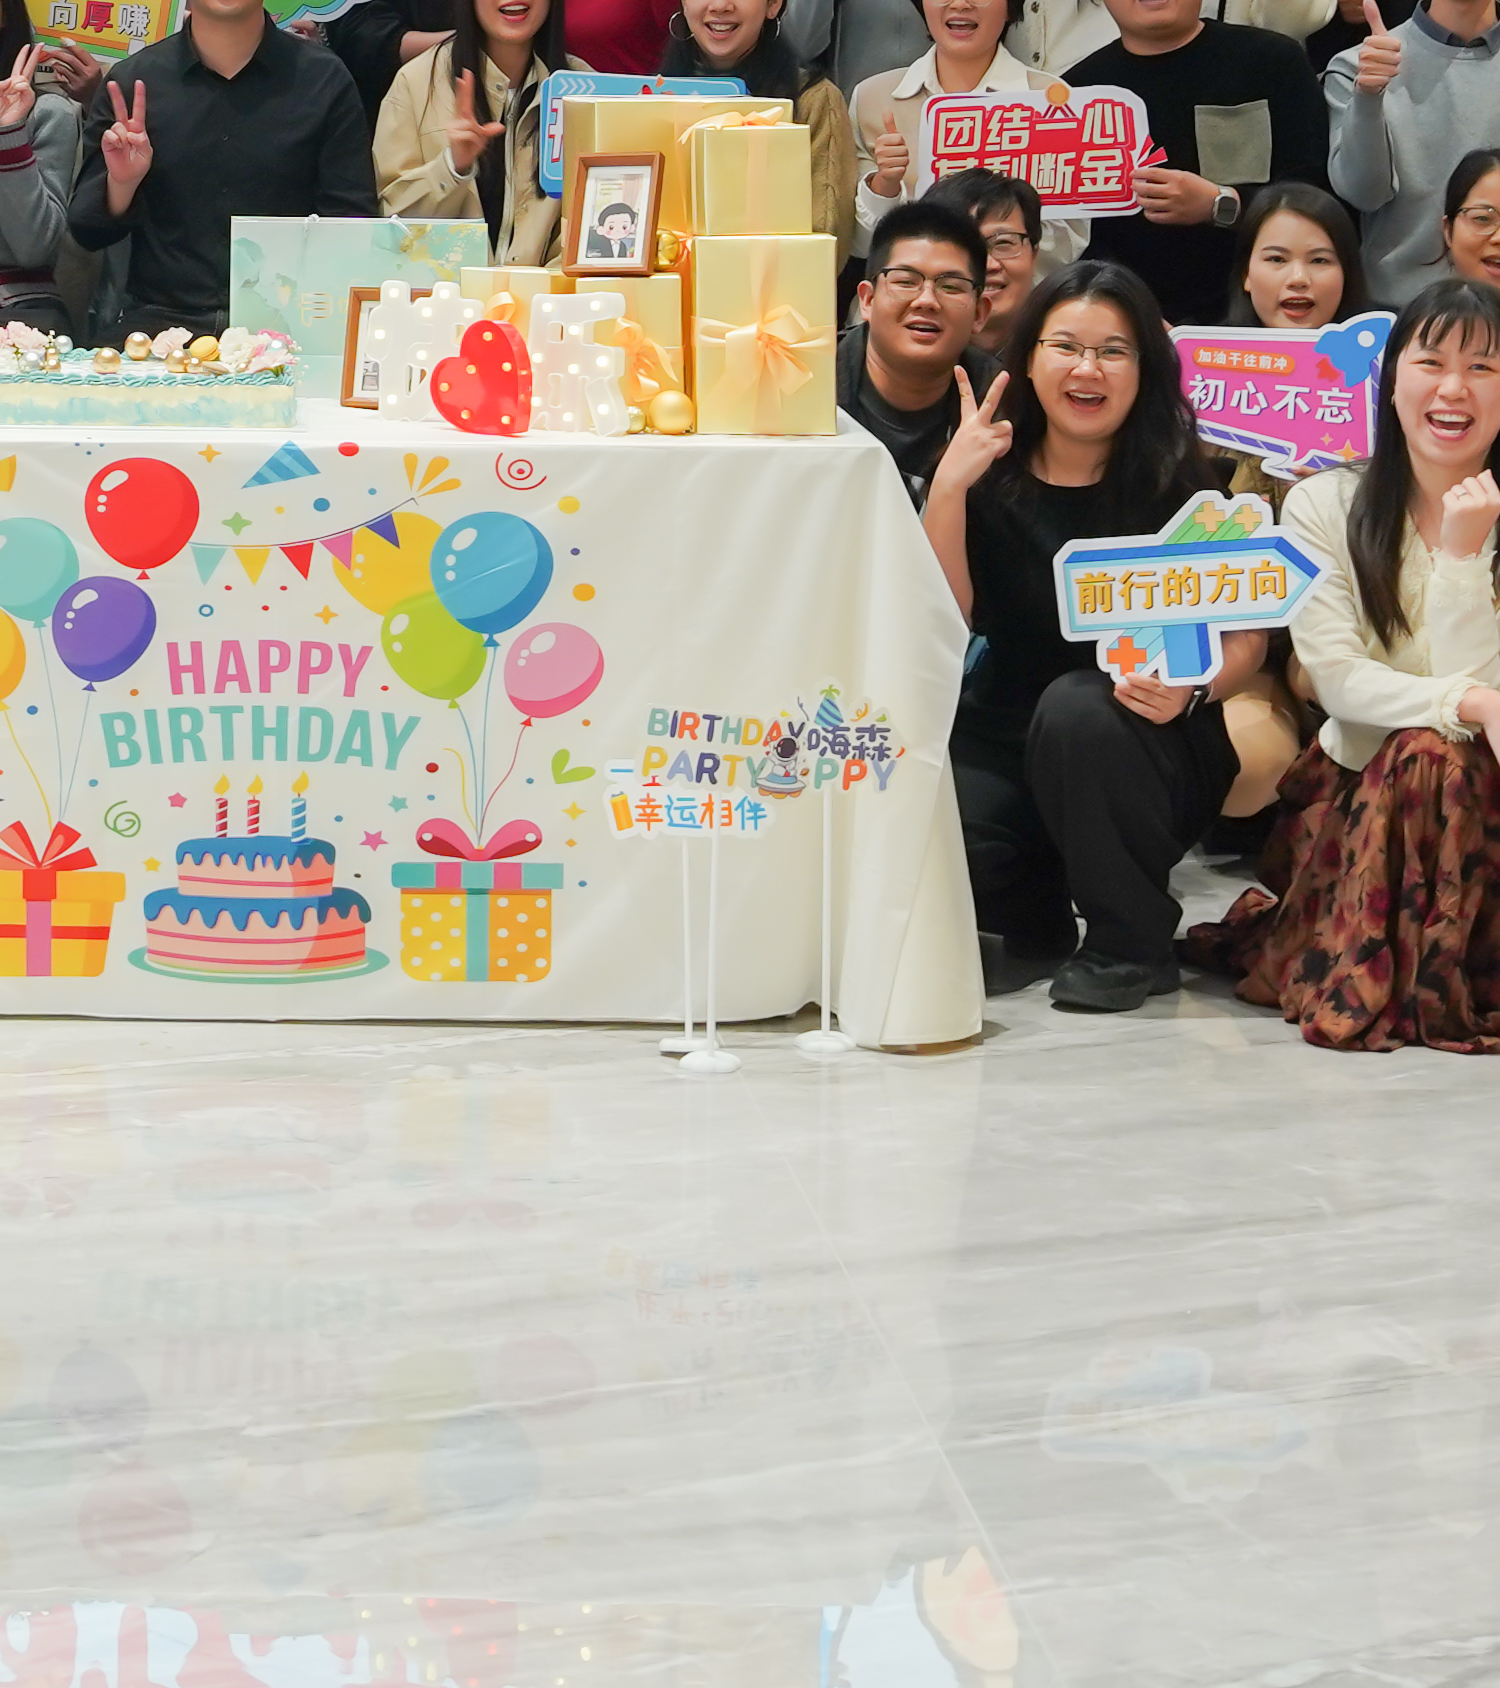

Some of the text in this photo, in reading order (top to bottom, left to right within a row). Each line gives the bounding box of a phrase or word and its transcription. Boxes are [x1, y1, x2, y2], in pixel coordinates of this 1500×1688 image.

[937, 102, 1127, 154] 团结一心
[1188, 373, 1354, 424] 初心不忘
[1074, 558, 1288, 615] 前行的方向
[166, 638, 374, 699] HAPPY
[99, 704, 422, 772] BIRTHDAY
